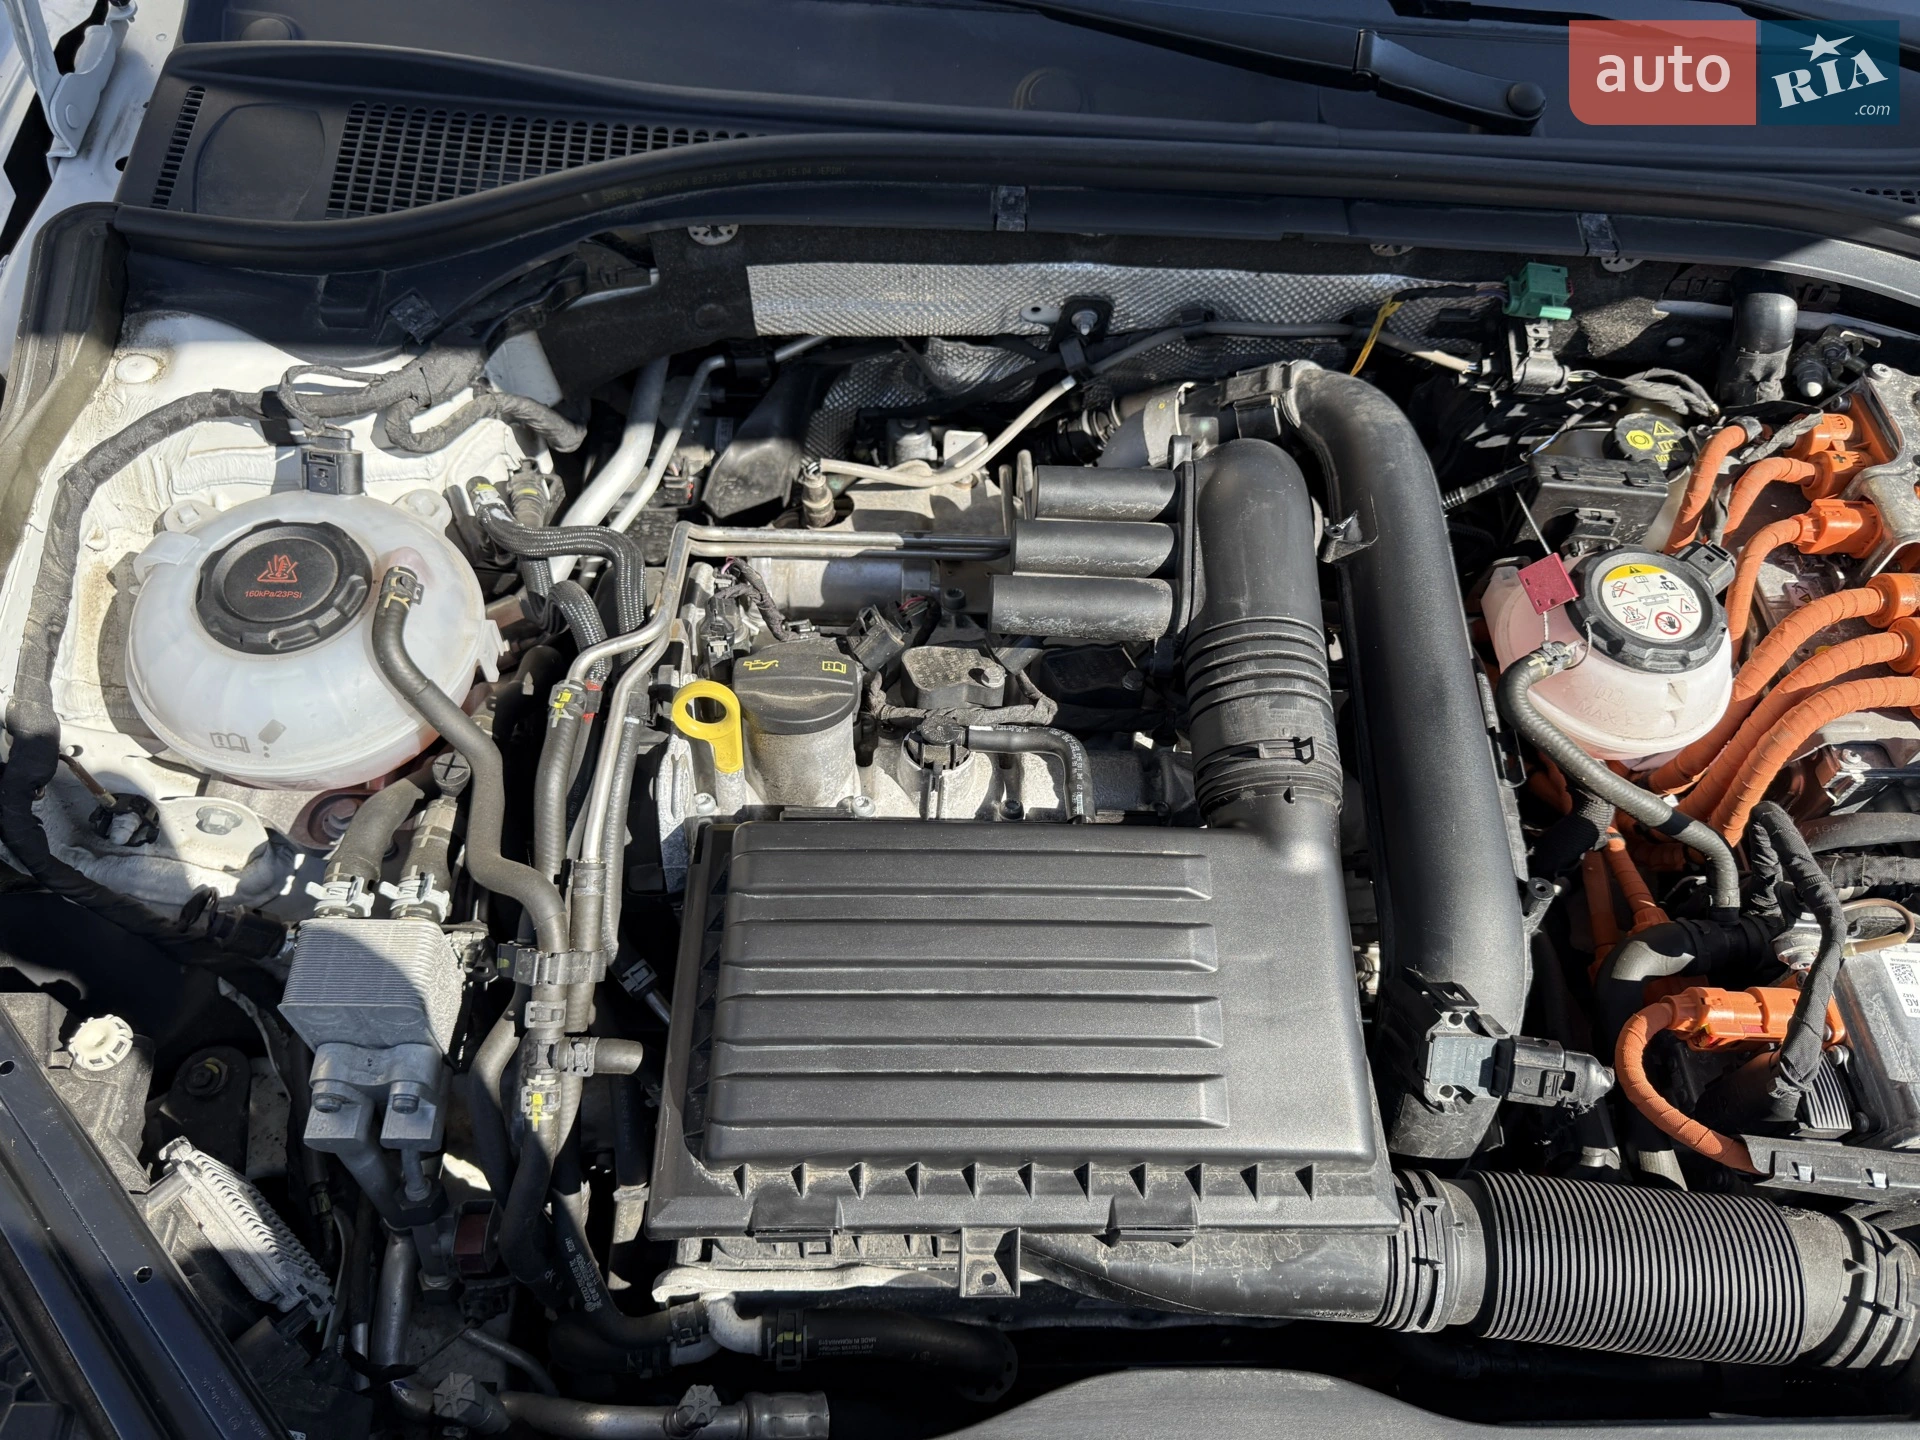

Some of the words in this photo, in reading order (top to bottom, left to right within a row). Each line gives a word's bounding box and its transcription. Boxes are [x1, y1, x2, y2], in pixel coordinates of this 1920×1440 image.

[244, 590, 303, 599] 160kPa/23PSI
[1575, 697, 1617, 725] MAX
[1905, 998, 1919, 1007] AG
